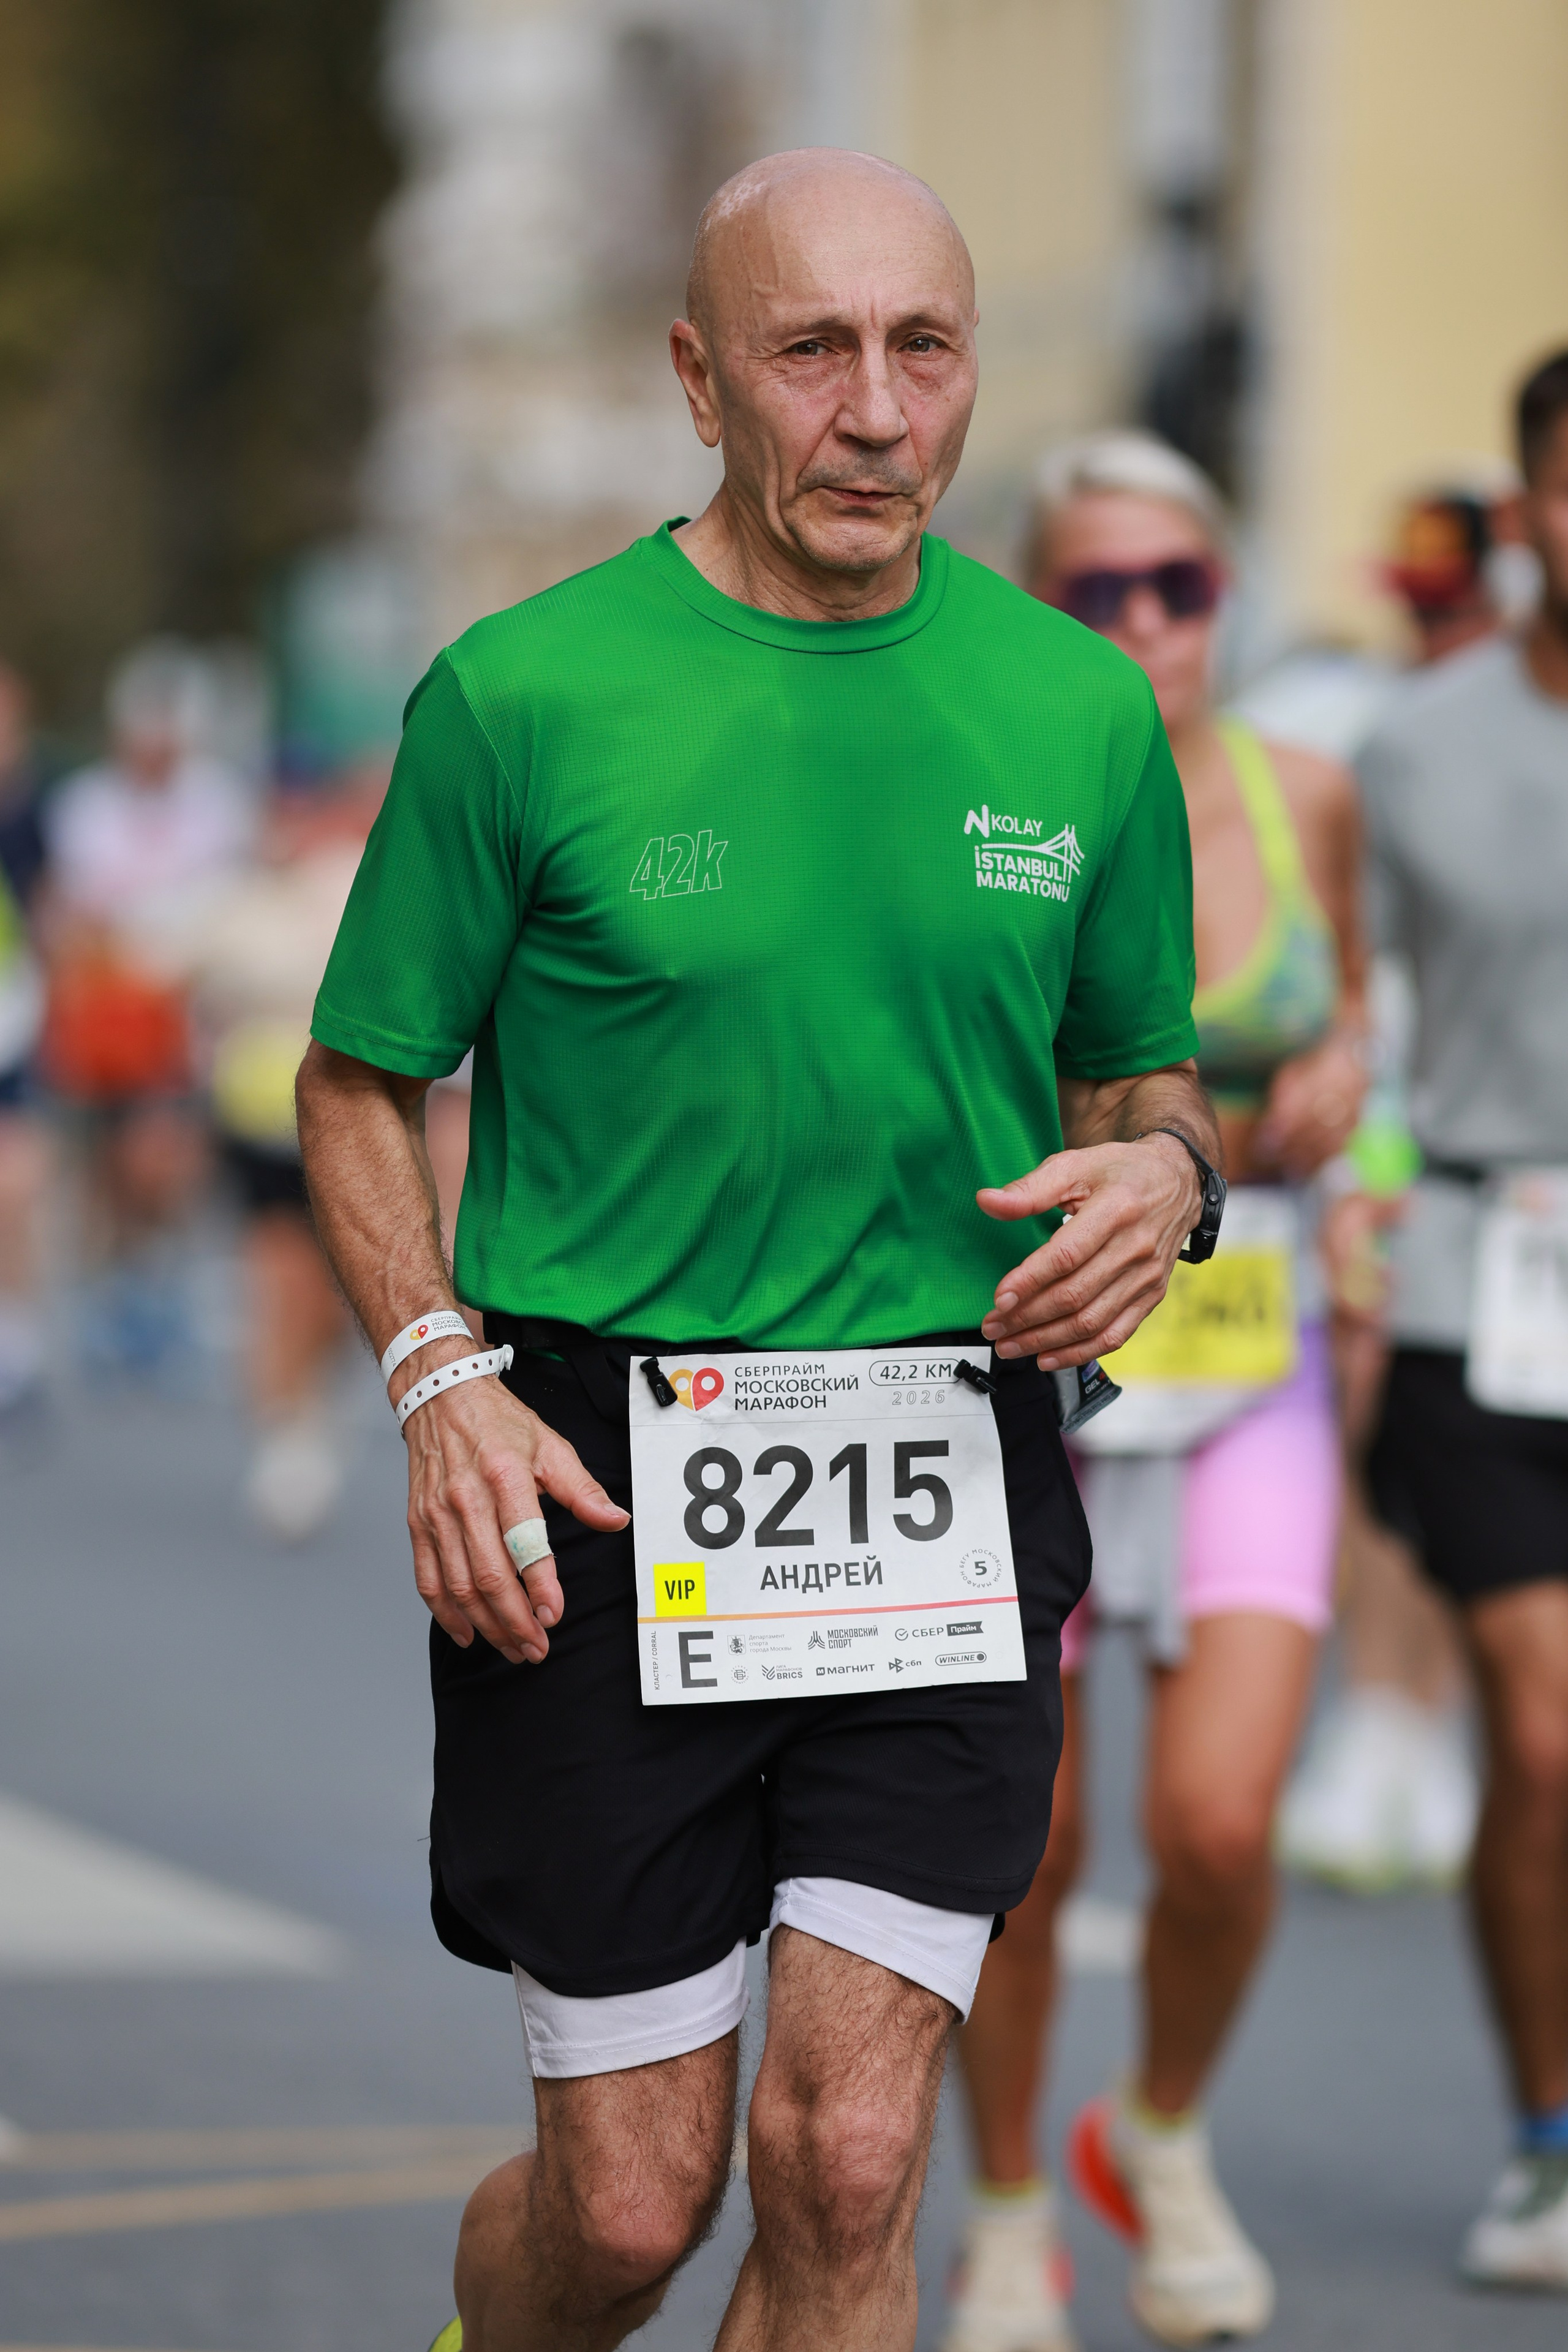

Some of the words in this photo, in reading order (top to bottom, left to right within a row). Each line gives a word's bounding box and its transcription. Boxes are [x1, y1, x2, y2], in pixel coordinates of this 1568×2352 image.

[991, 814, 1042, 837] KOLAY
[976, 870, 1069, 902] MARATONU
[734, 1362, 825, 1378] СБЕРПРАЙМ
[880, 1365, 918, 1381] 42,2
[734, 1374, 859, 1395] МОСКОВСКИЙ
[1085, 1379, 1100, 1394] GEL
[734, 1395, 827, 1411] МАРАФОН
[892, 1389, 945, 1406] 2026
[683, 1439, 954, 1550] 8215
[760, 1555, 883, 1594] АНДРЕЙ
[974, 1561, 987, 1576] 5
[665, 1579, 695, 1600] VIP
[827, 1625, 878, 1639] МОСКОВСКИЙ
[911, 1627, 944, 1638] СБЕР
[950, 1624, 976, 1634] Прайм
[828, 1639, 852, 1649] СПОРТ
[939, 1654, 975, 1664] WINLINE
[777, 1672, 803, 1680] BRICS
